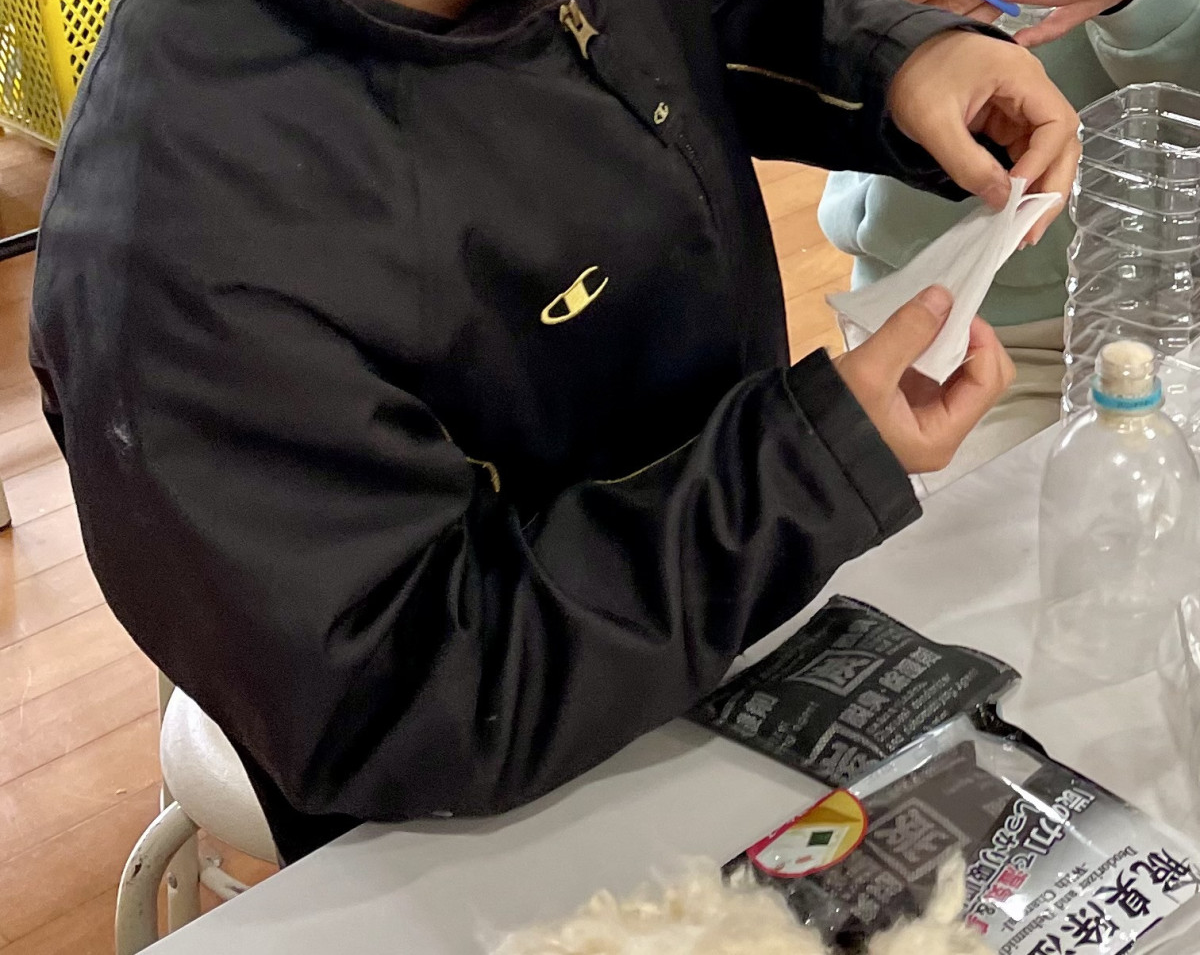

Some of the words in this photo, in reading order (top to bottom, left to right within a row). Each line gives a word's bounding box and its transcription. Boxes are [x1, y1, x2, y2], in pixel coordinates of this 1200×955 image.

[1080, 845, 1138, 890] Deodorizer
[1056, 889, 1078, 911] and
[999, 908, 1057, 955] Dehumid
